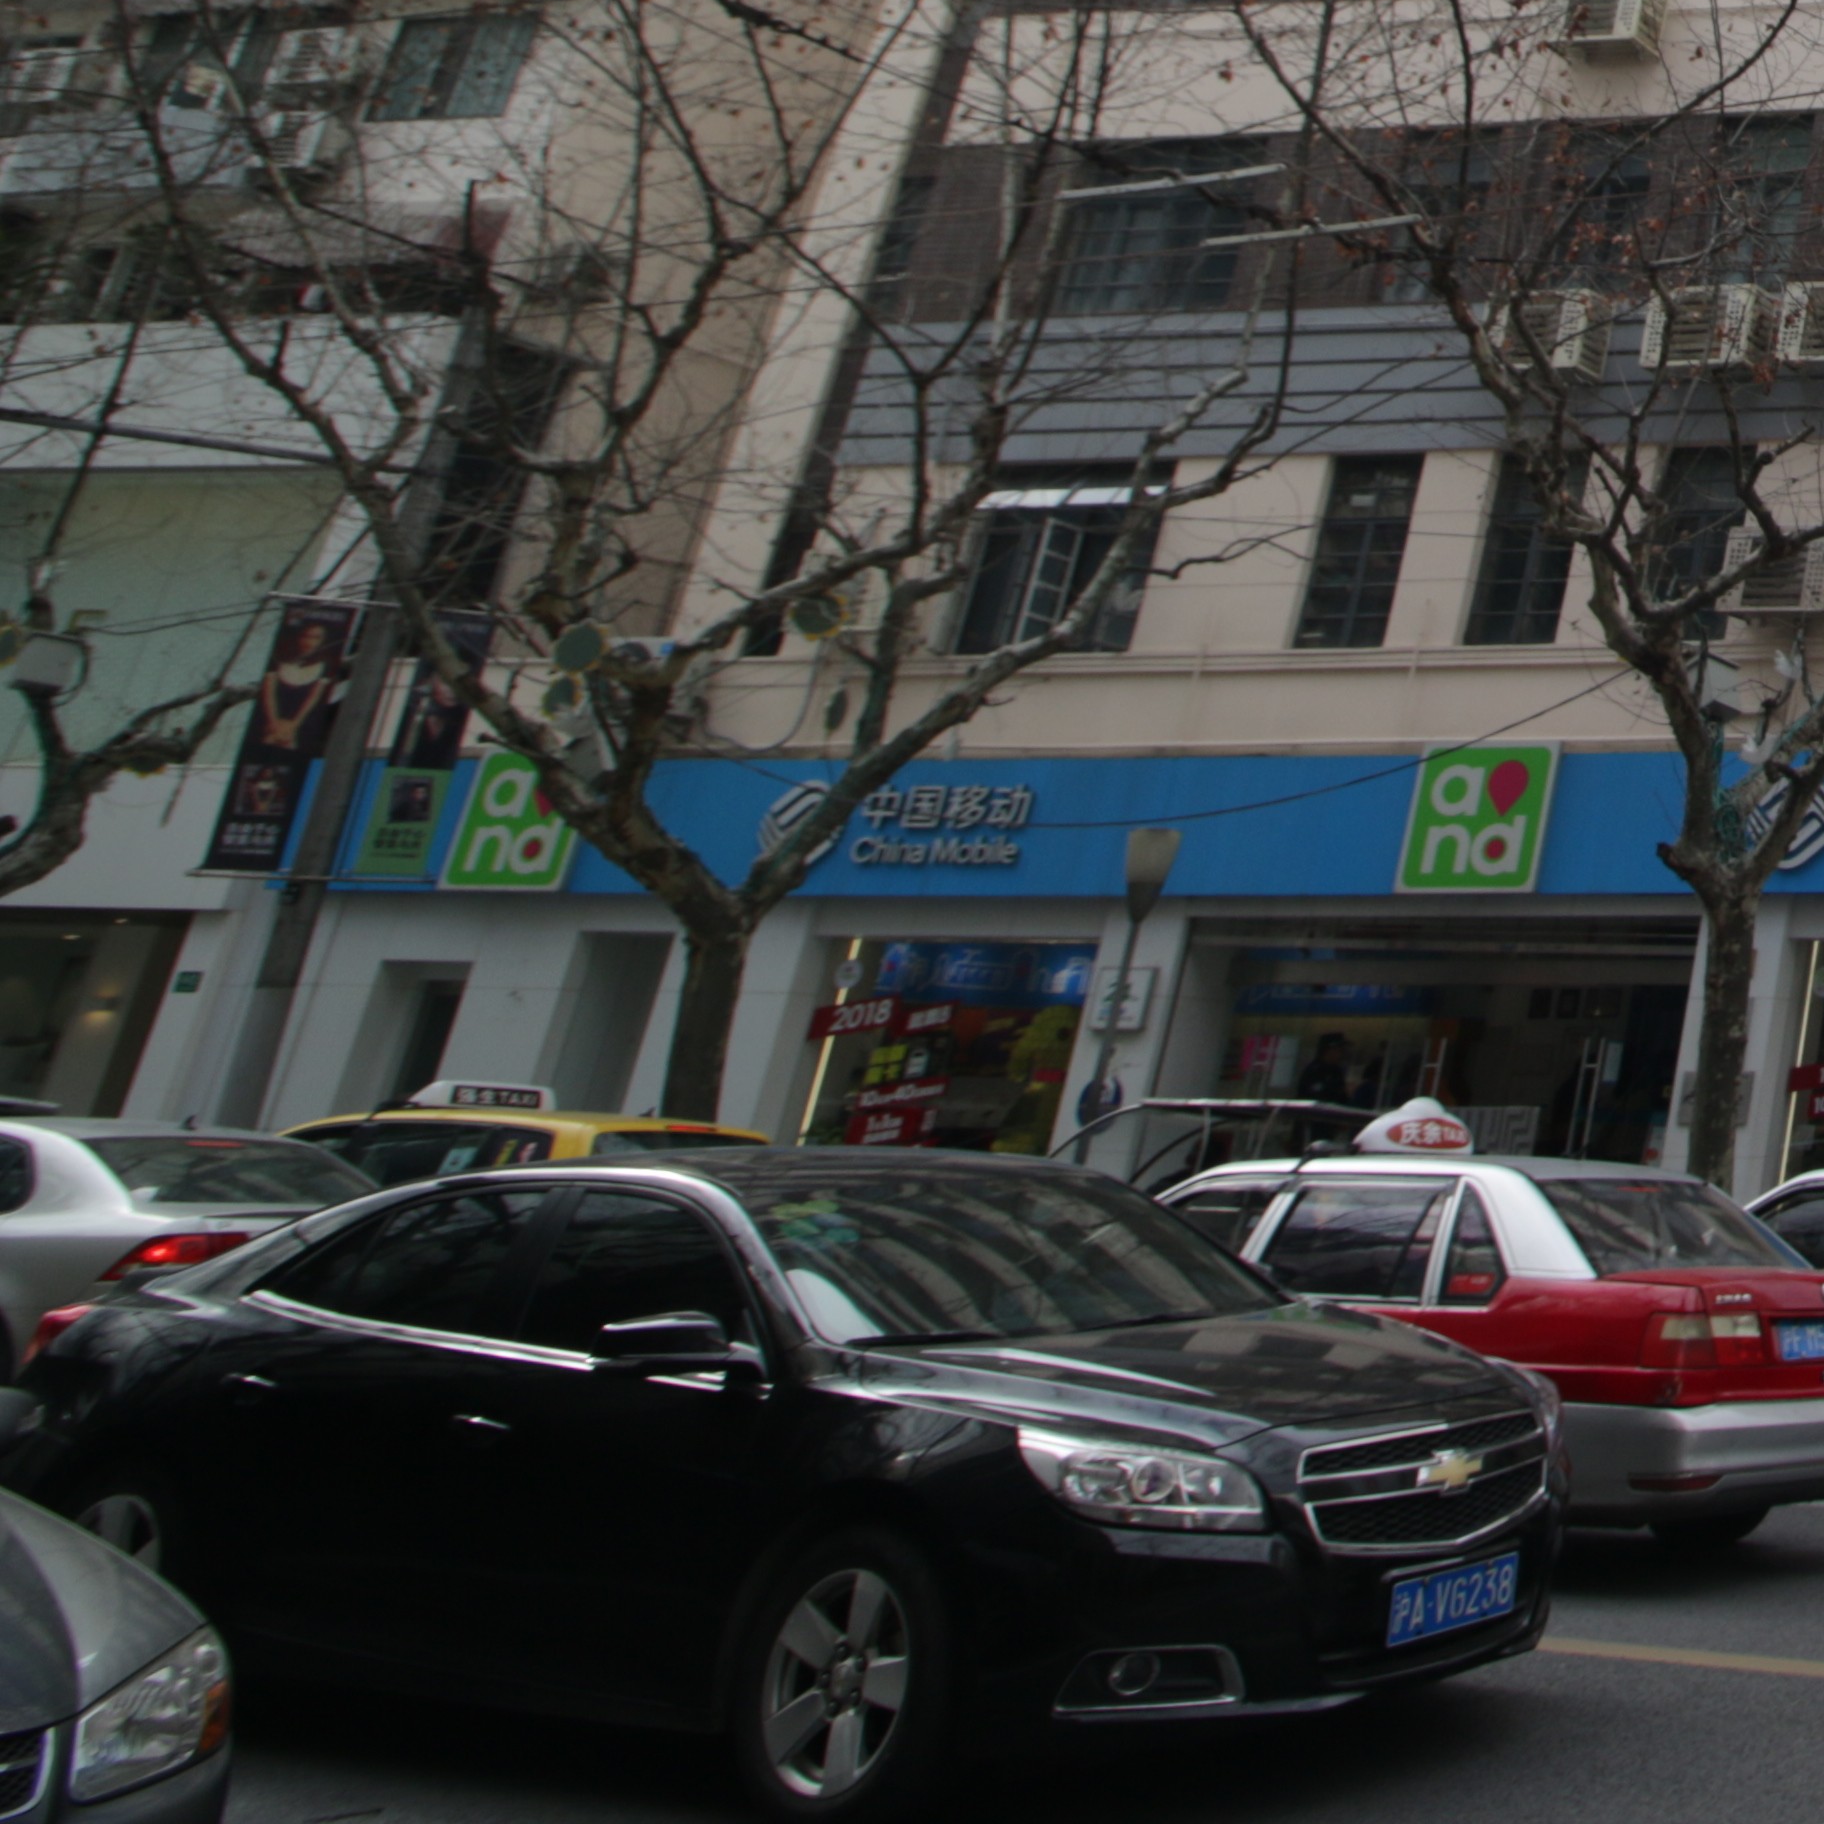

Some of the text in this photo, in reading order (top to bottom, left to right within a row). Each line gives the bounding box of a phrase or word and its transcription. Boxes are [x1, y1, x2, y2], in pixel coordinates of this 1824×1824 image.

[862, 784, 1033, 828] 中国移动
[851, 834, 1018, 865] China Mobile
[829, 998, 893, 1032] 2018
